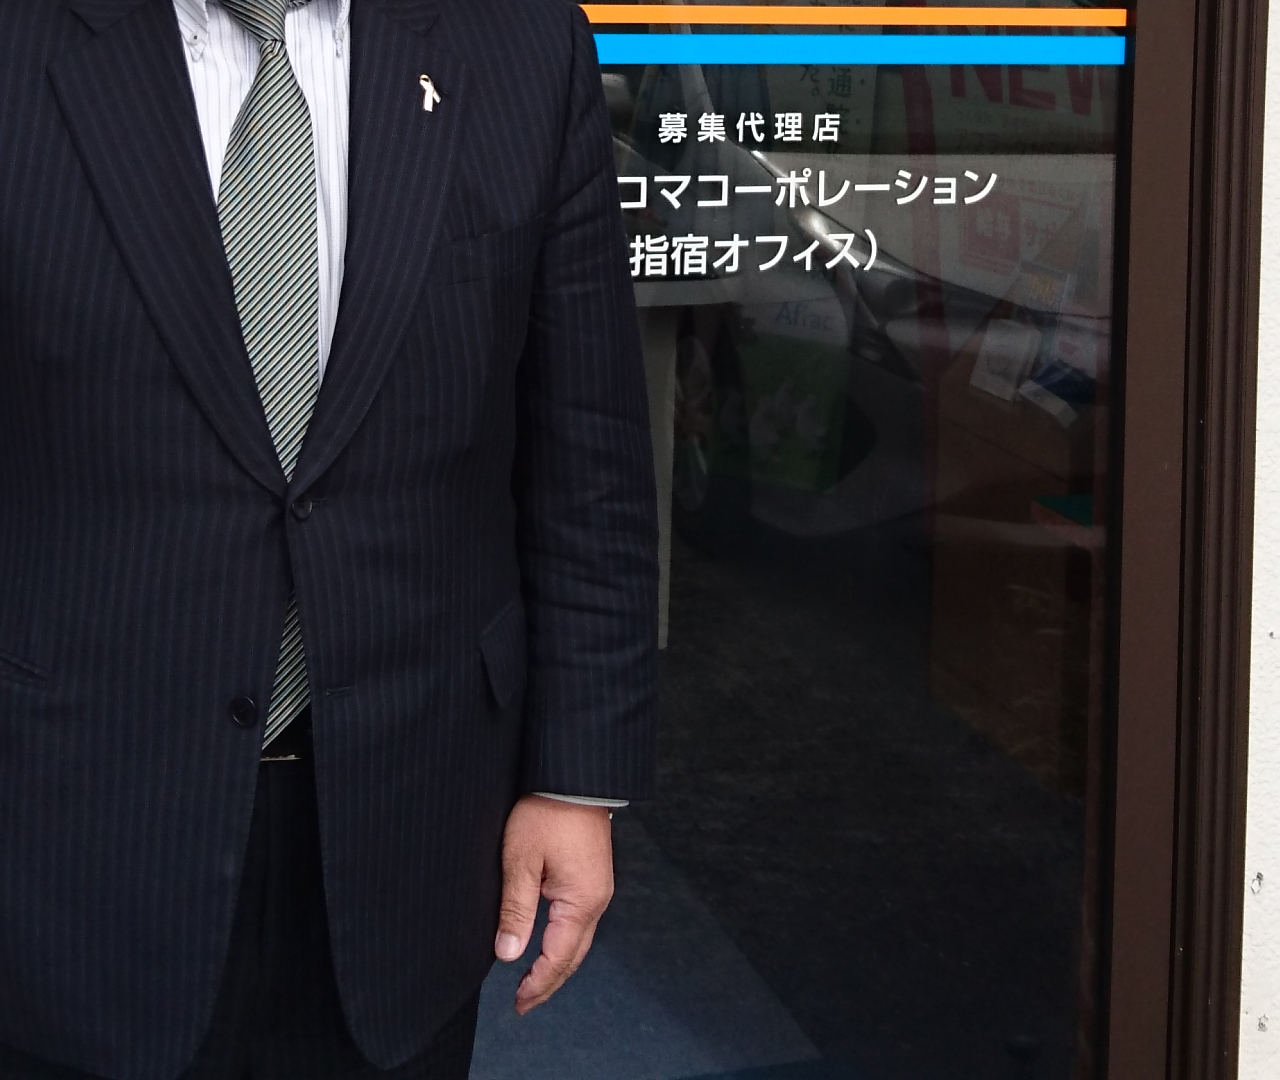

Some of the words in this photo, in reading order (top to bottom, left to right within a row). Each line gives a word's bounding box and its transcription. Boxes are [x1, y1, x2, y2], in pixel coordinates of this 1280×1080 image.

[658, 112, 841, 144] 募集代理店
